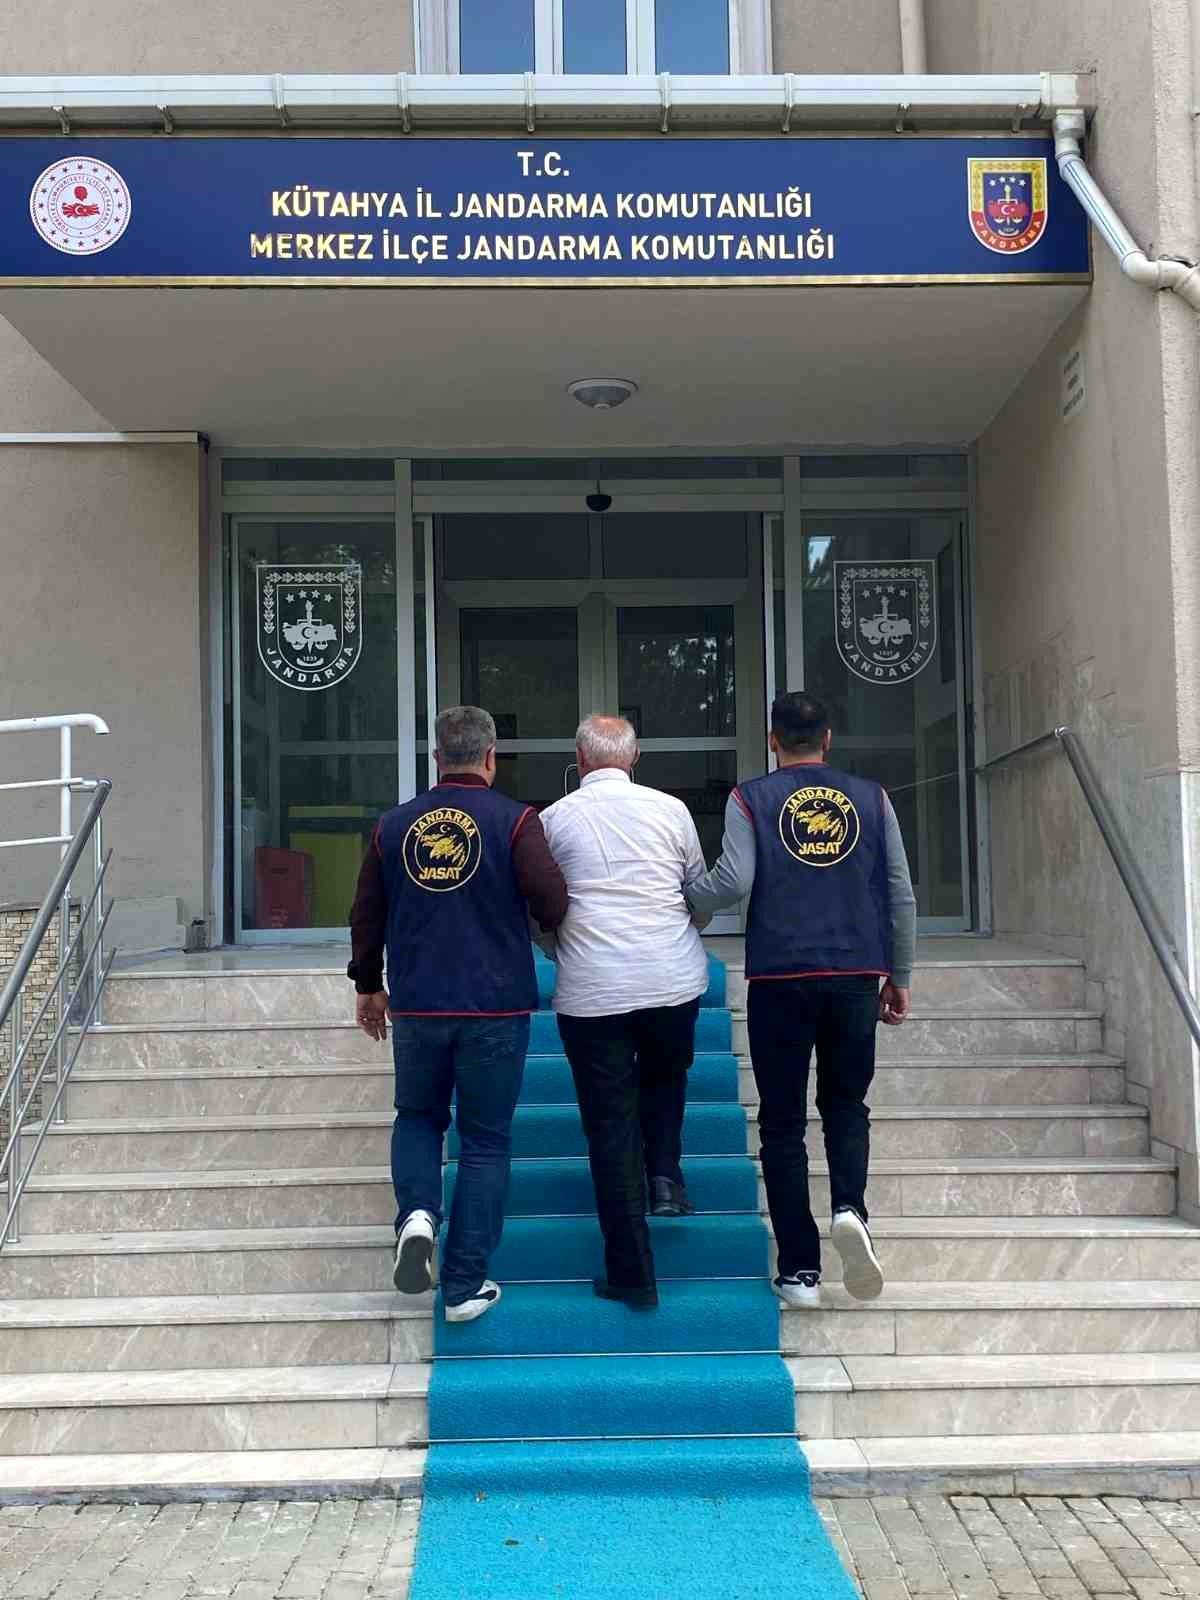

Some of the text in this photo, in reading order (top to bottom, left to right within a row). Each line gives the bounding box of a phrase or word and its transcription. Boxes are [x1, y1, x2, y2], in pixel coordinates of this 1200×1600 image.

[517, 151, 570, 177] T.C.
[272, 185, 812, 219] KÜTAHYA İL JANDARMA KOMUTANLIĞI
[250, 228, 834, 264] MERKEZ İLÇE JANDARMA KOMUTANLIĞI
[976, 219, 1041, 249] JANDARMA
[266, 647, 354, 684] JANDARMA
[844, 641, 929, 677] JANDARMA
[787, 789, 851, 814] JANDARMA
[412, 810, 476, 838] JANDARMA
[798, 841, 842, 855] JASAT
[418, 867, 462, 880] JASAT
